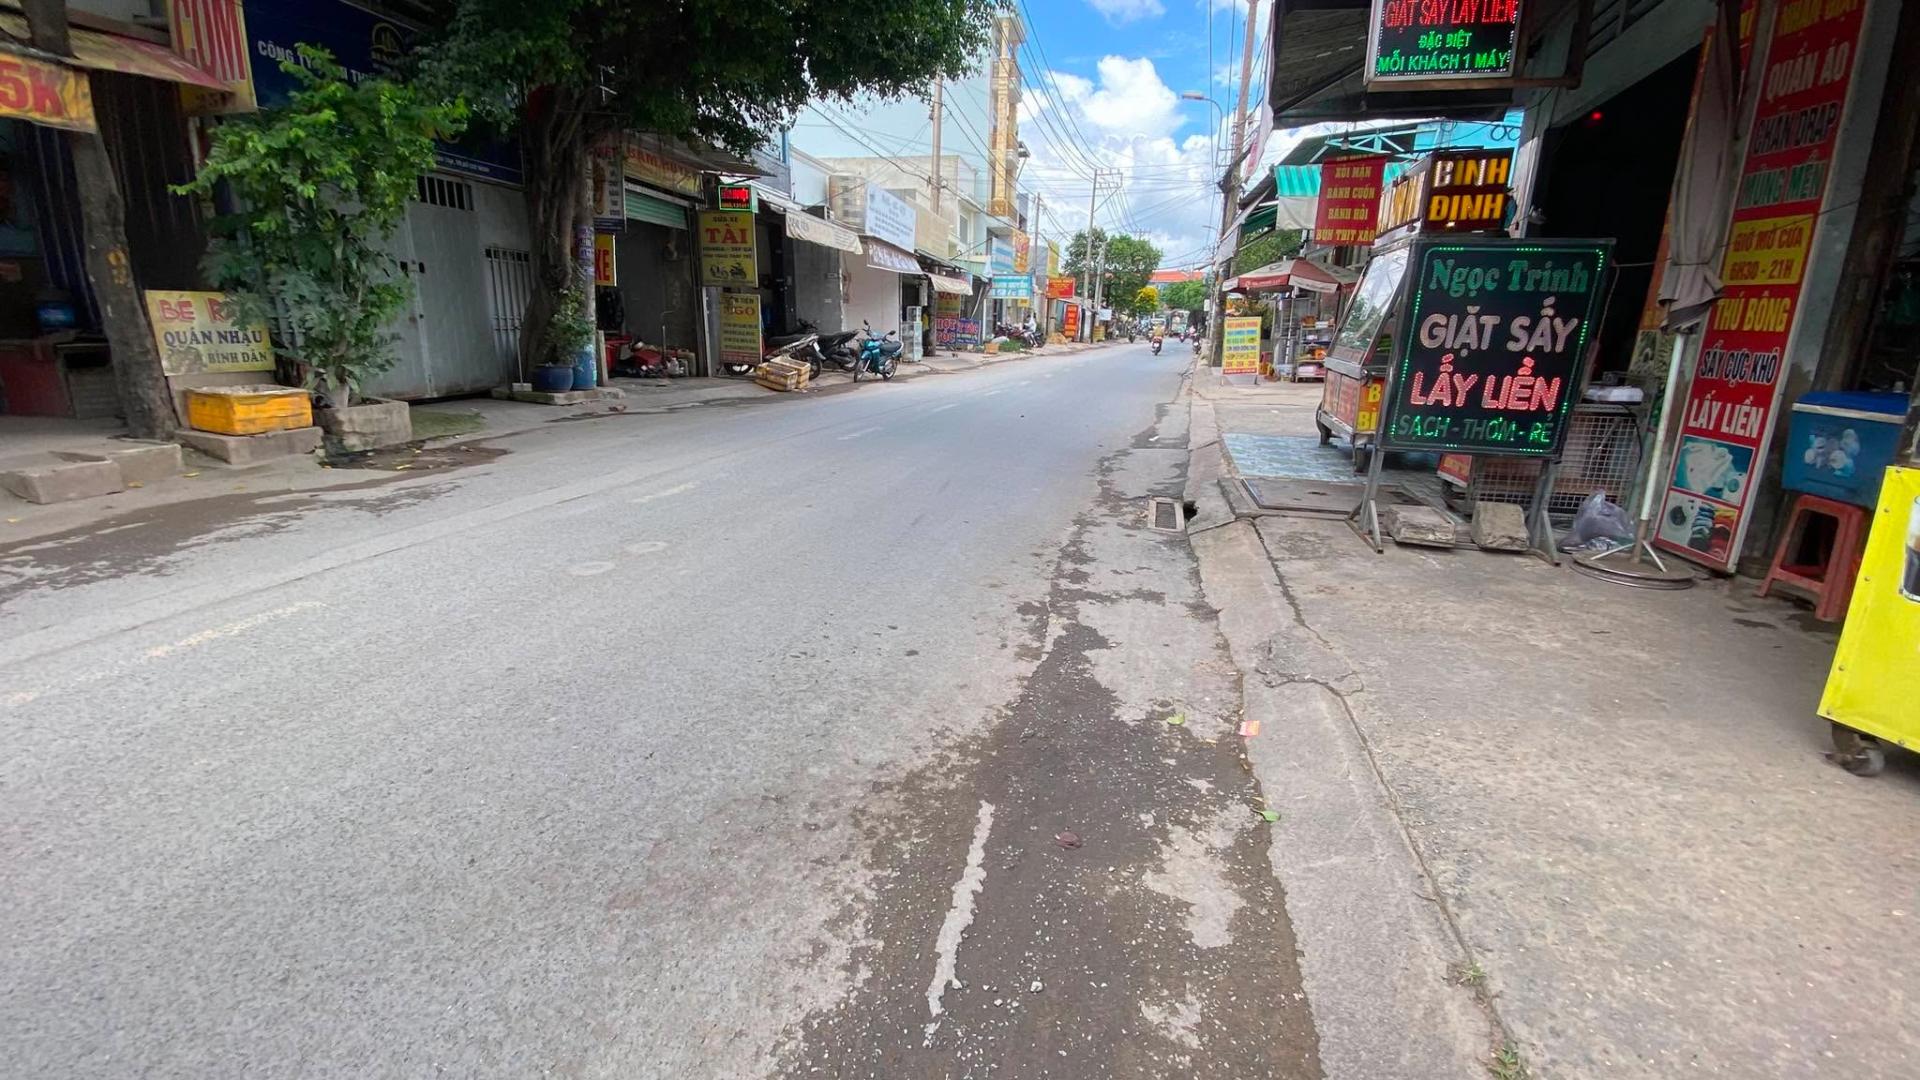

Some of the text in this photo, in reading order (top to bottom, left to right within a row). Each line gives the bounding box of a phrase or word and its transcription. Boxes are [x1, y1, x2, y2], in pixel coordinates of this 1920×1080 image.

[257, 40, 295, 63] CÔNG
[1418, 28, 1472, 50] ĐẶC BIỆT
[1378, 49, 1508, 72] MỖI KHÁCH 1 MÁY
[1429, 194, 1505, 227] ĐỊNH
[705, 223, 748, 244] TÀI
[1429, 258, 1501, 297] Ngọc
[1419, 295, 1579, 357] GIẶT SẤY
[1713, 290, 1792, 333] THÚ BÔNG
[1409, 353, 1479, 407] LẤY
[1481, 356, 1562, 411] LIỀN
[1700, 339, 1781, 388] SẤY CỰC KHÔ
[1687, 389, 1765, 439] LẤY LIỀN
